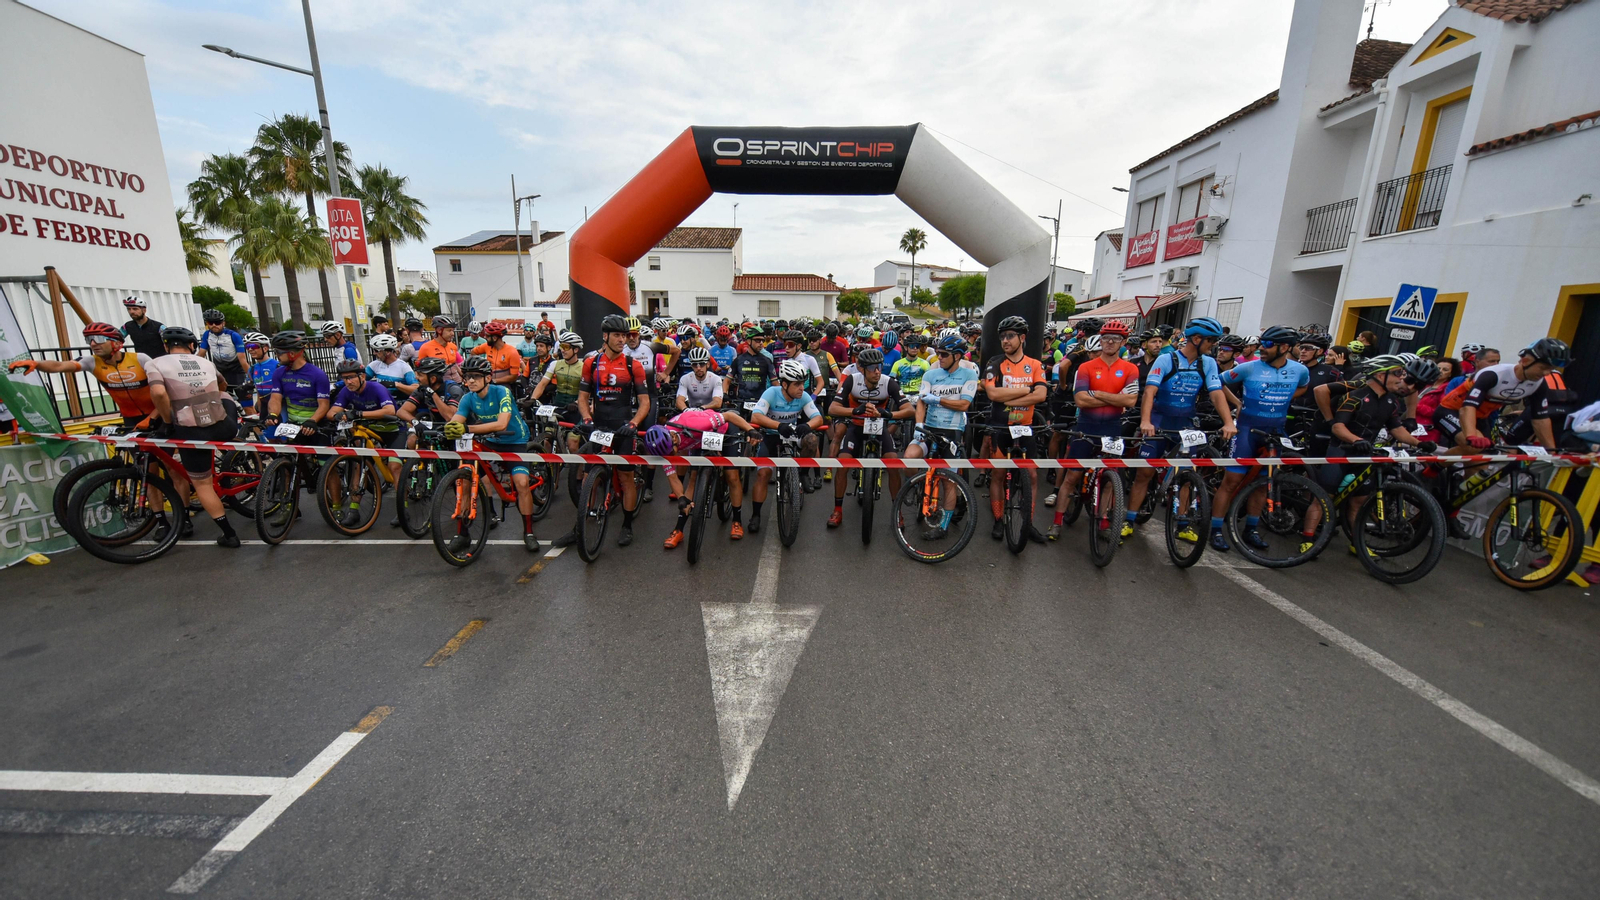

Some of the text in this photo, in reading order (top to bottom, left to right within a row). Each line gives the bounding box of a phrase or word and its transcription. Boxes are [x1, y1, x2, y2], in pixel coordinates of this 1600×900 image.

[32, 217, 151, 252] FEBRERO
[330, 225, 360, 240] PSOE
[594, 430, 611, 442] 496
[703, 437, 721, 446] 244
[1184, 432, 1204, 443] 404
[1104, 441, 1122, 451] 238
